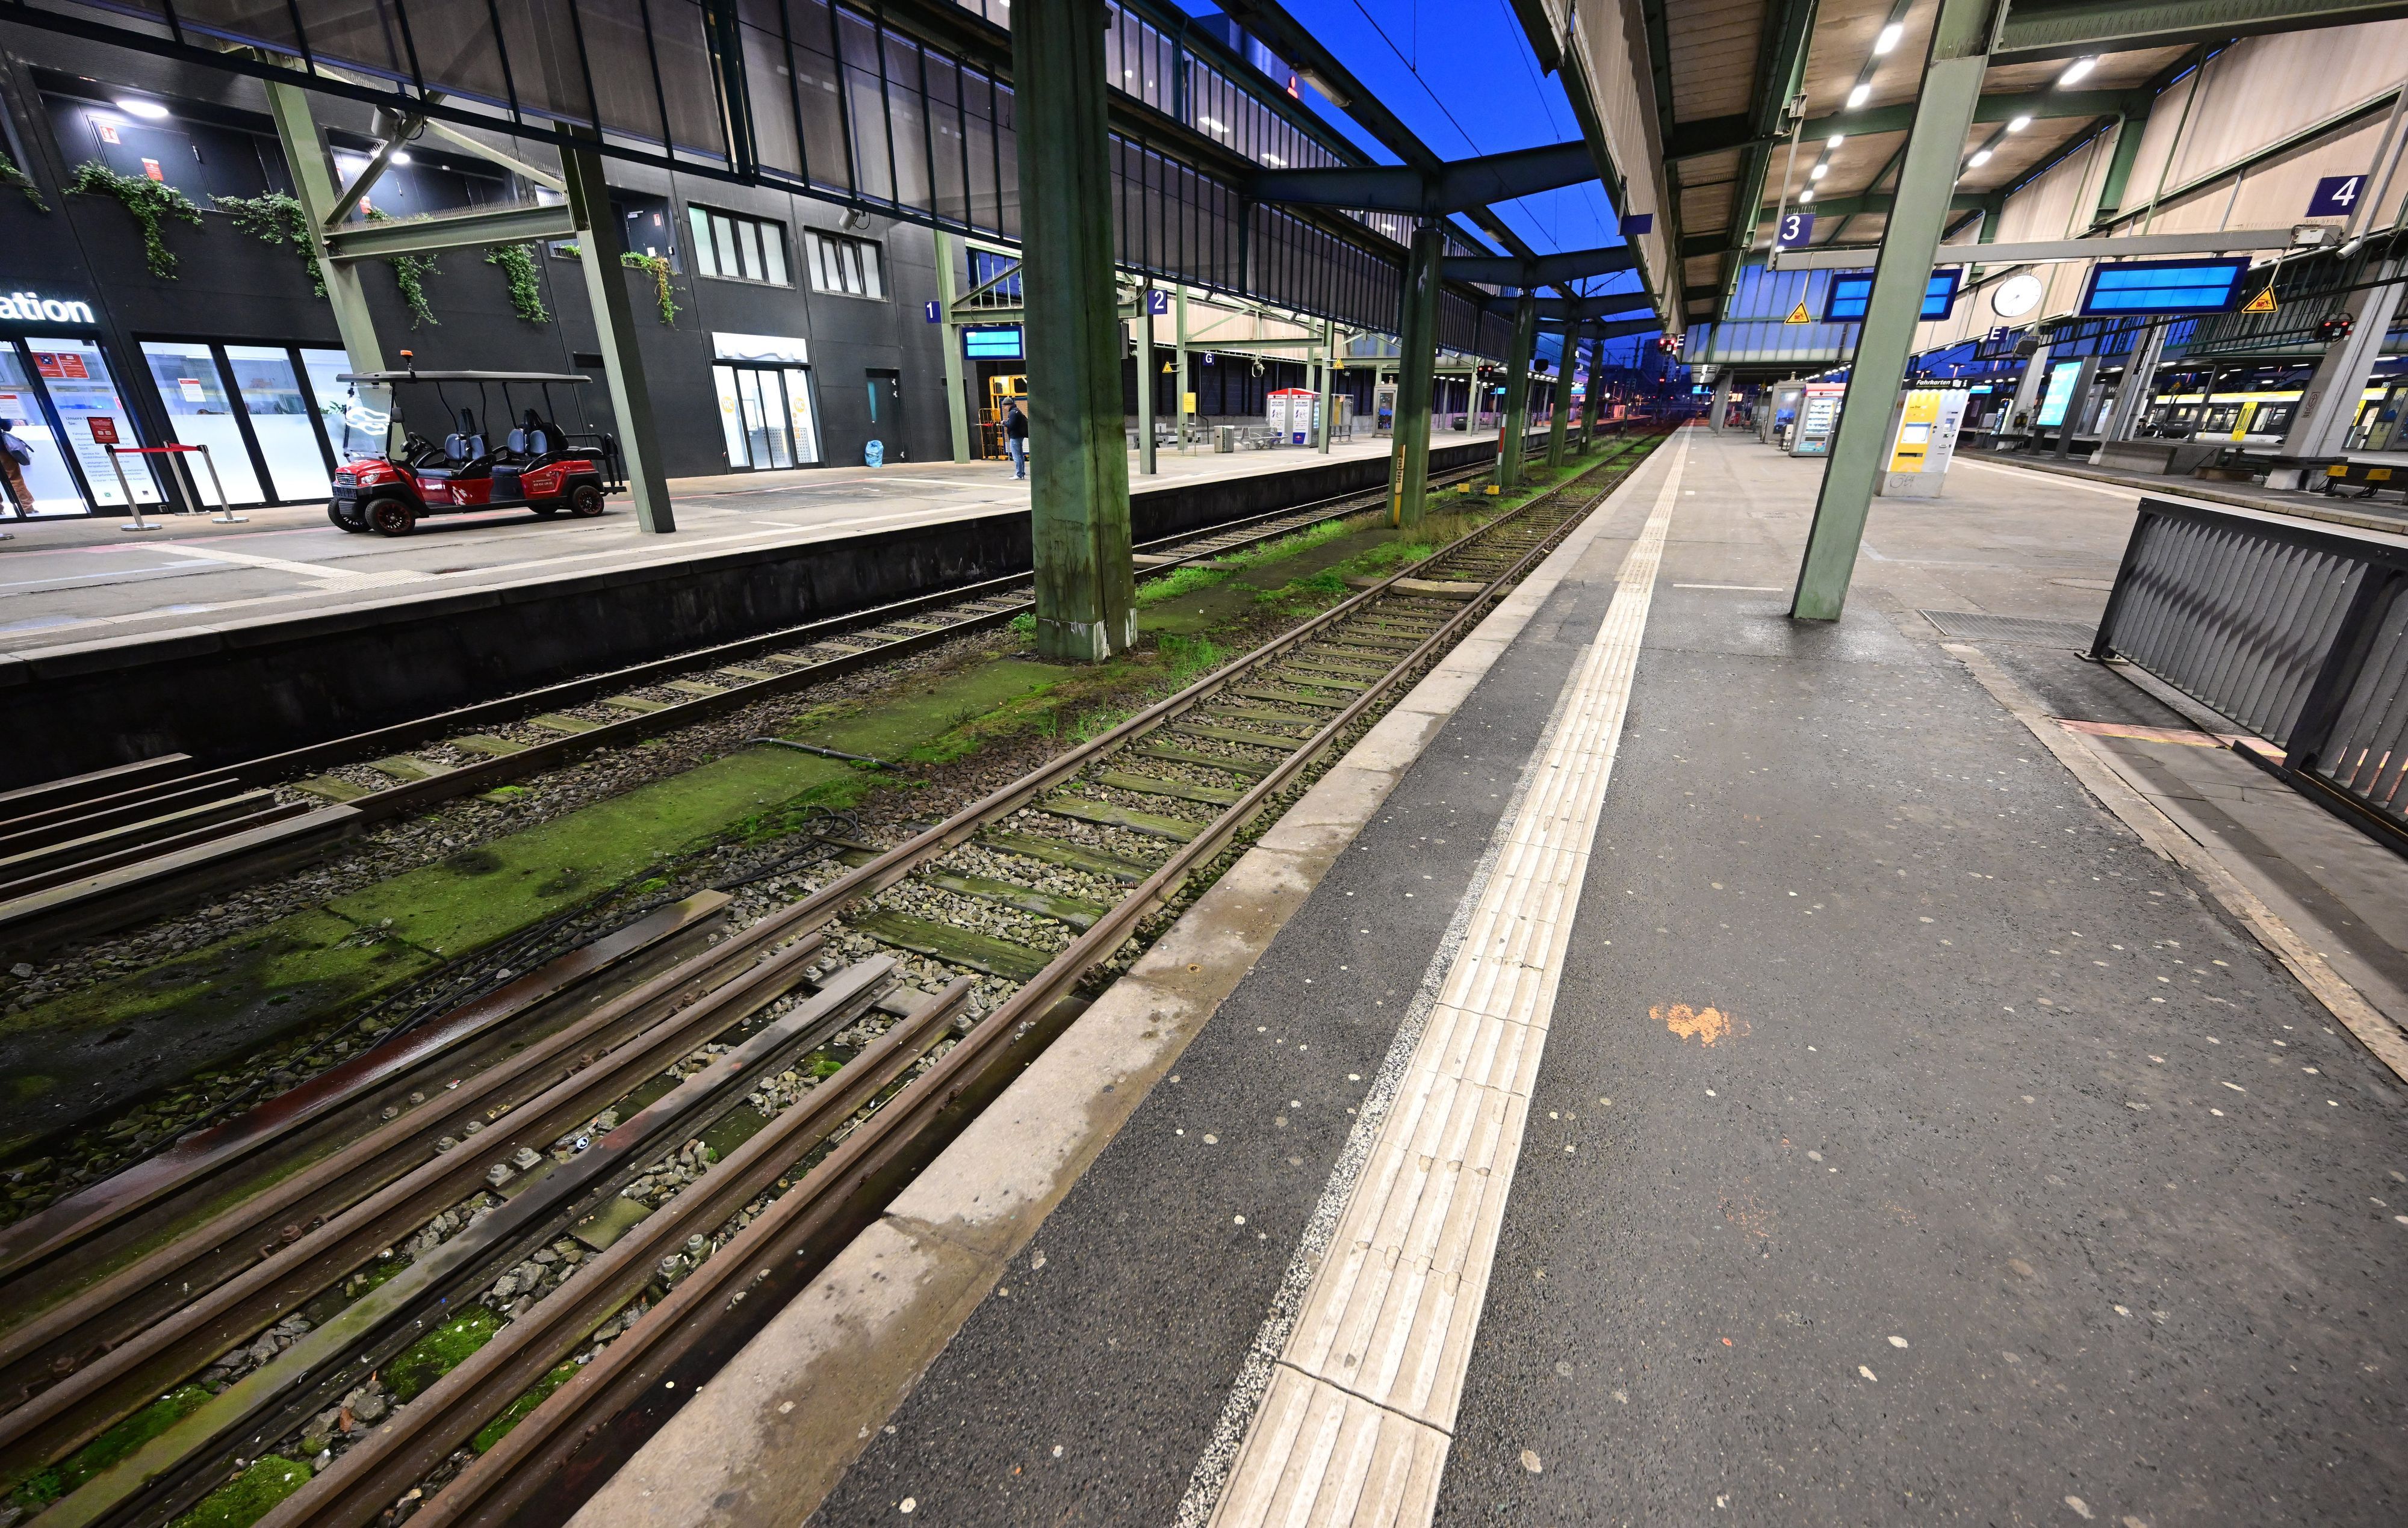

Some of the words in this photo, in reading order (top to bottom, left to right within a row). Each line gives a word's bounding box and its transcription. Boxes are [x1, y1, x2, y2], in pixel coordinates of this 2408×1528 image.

[2332, 177, 2359, 206] 4
[1782, 215, 1801, 240] 3
[1154, 291, 1164, 309] 2
[926, 302, 933, 318] 1
[1990, 327, 2002, 340] E
[1205, 353, 1212, 363] G
